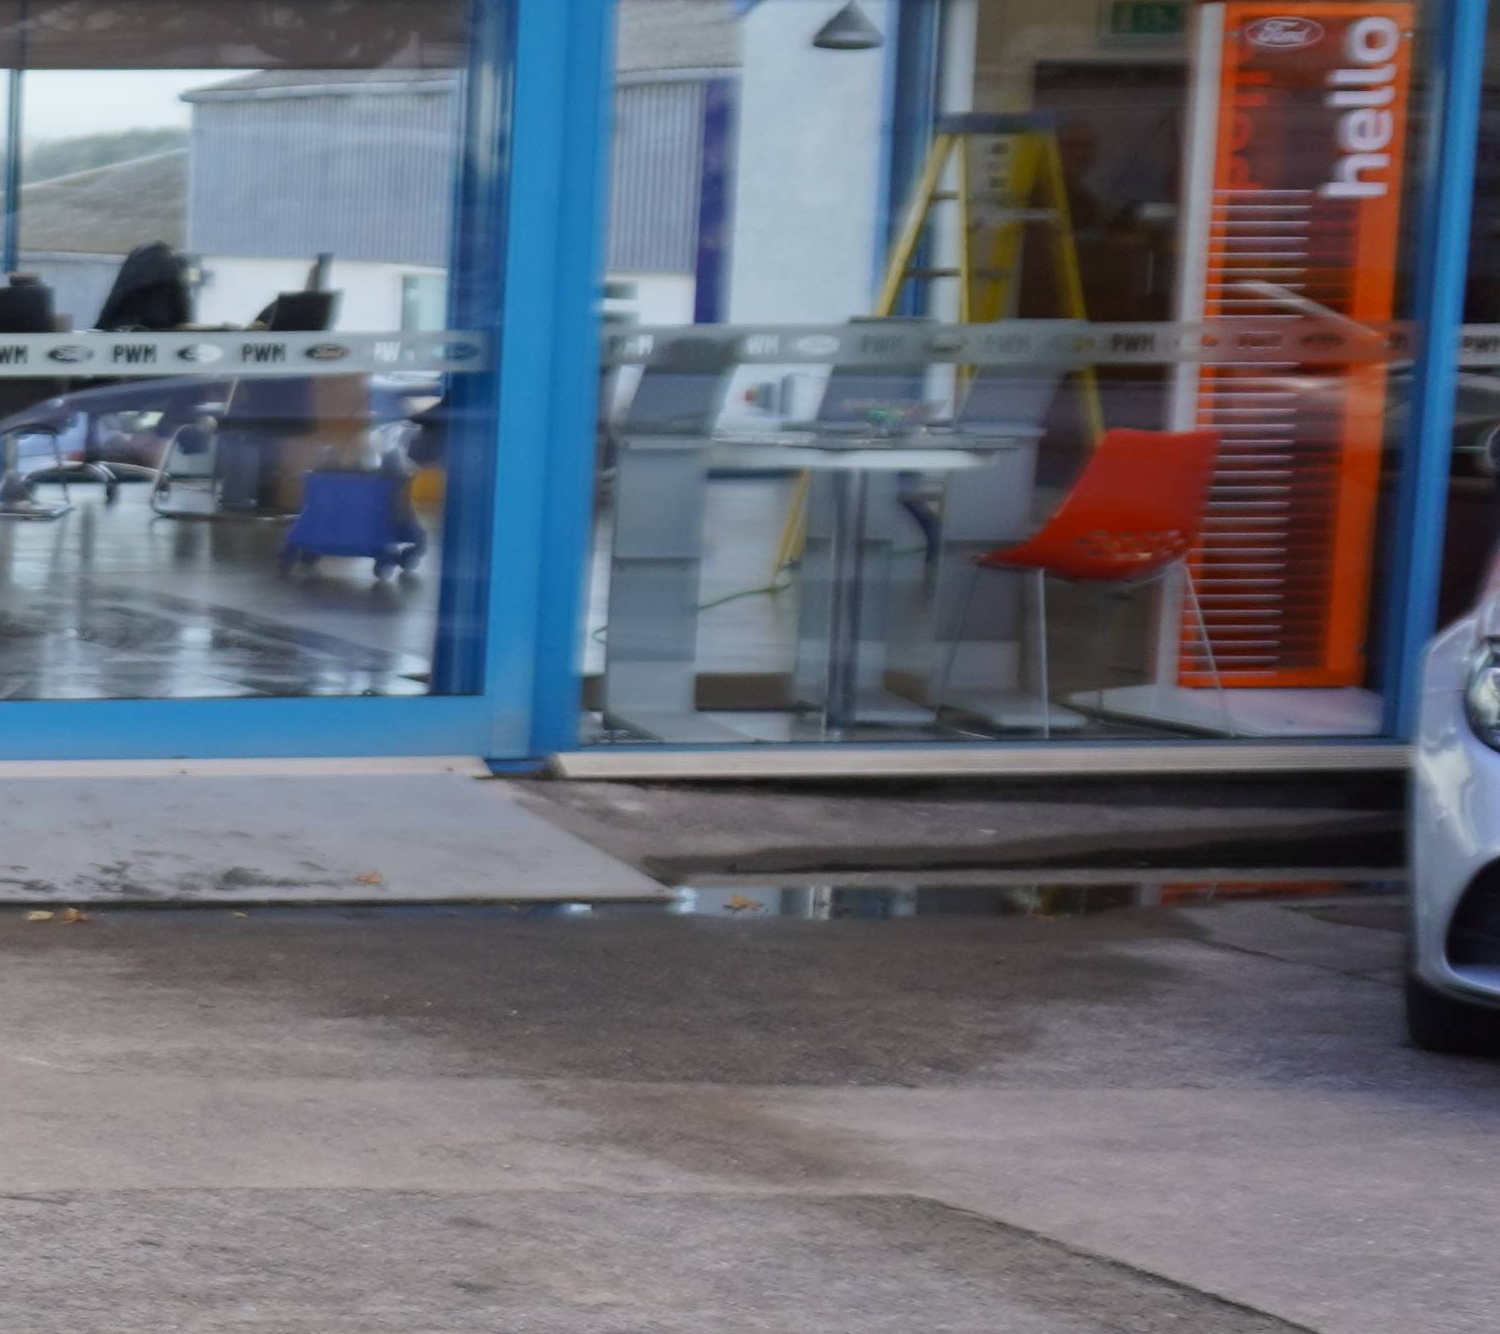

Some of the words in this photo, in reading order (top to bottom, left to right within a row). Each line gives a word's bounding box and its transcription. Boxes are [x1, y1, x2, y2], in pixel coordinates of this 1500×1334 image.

[1318, 16, 1400, 199] hello
[112, 343, 158, 364] PWM
[240, 342, 286, 363] PWM
